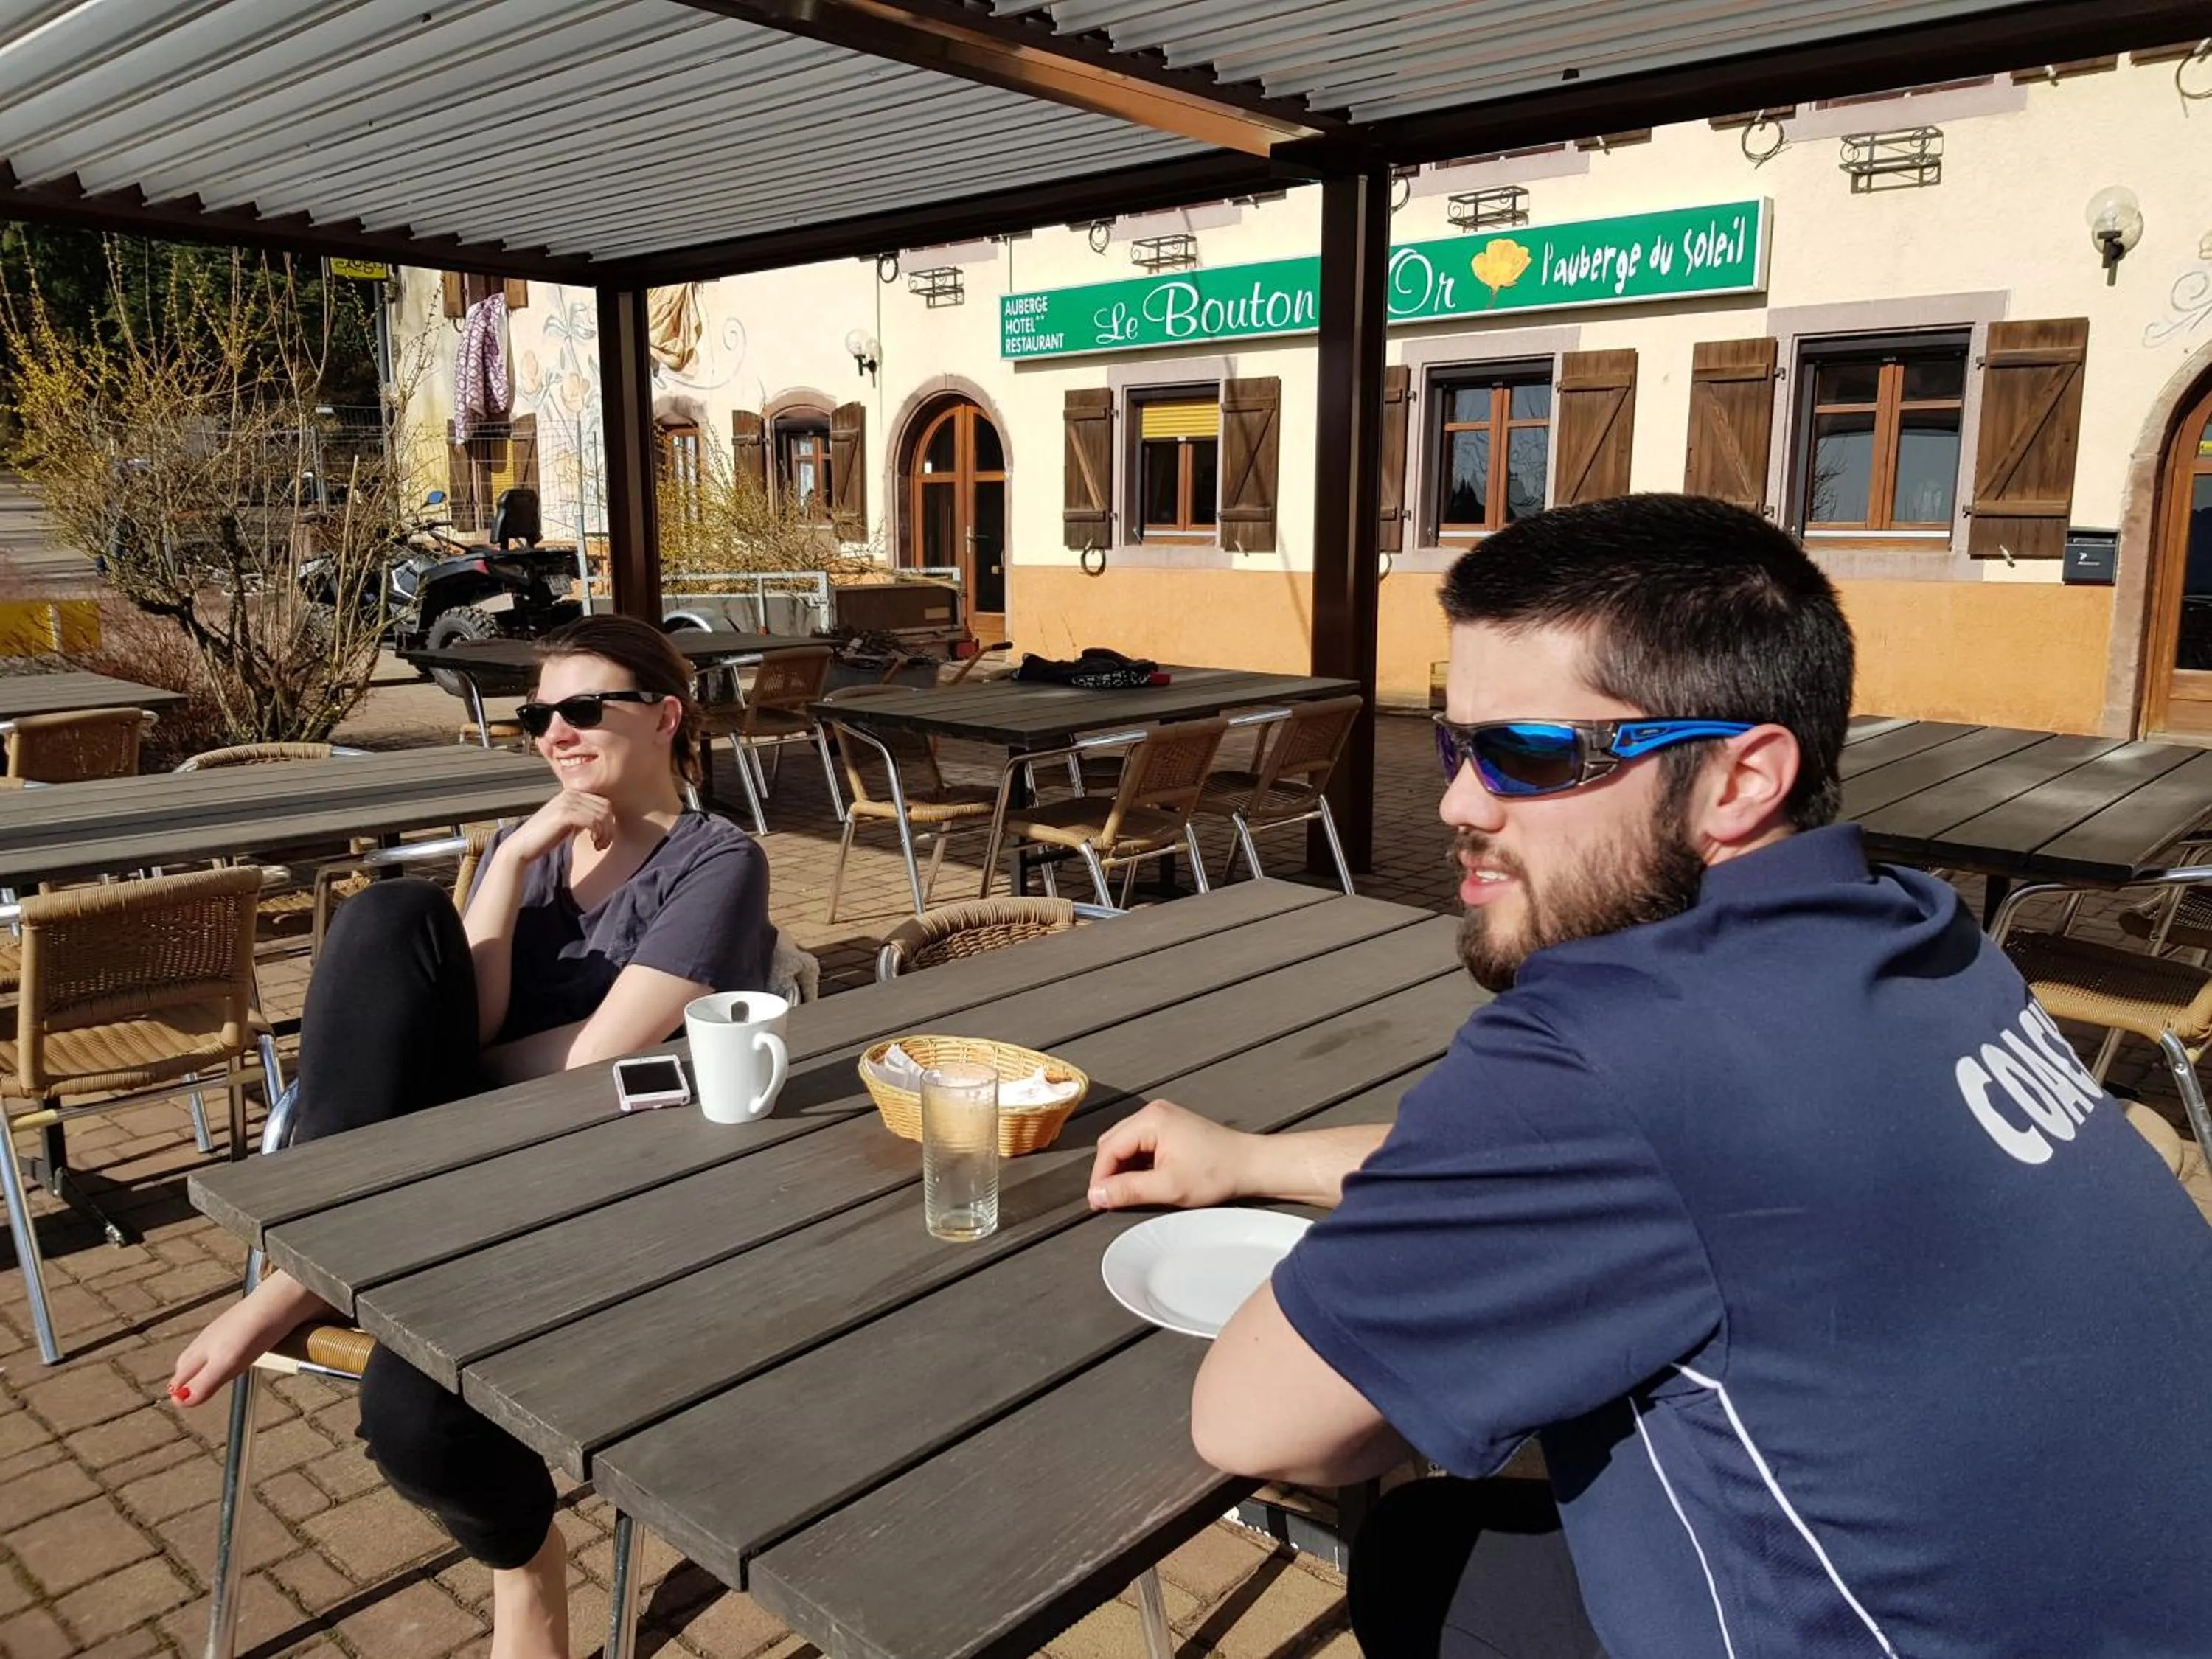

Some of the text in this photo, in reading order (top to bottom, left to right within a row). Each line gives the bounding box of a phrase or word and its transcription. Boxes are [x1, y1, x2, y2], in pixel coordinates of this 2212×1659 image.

[1542, 241, 1641, 295] l'auberge
[1649, 234, 1674, 276] du
[1004, 296, 1048, 316] AUBERGE
[1094, 301, 1138, 344] Le
[1143, 282, 1315, 337] Bouton
[1005, 333, 1065, 353] RESTAURANT
